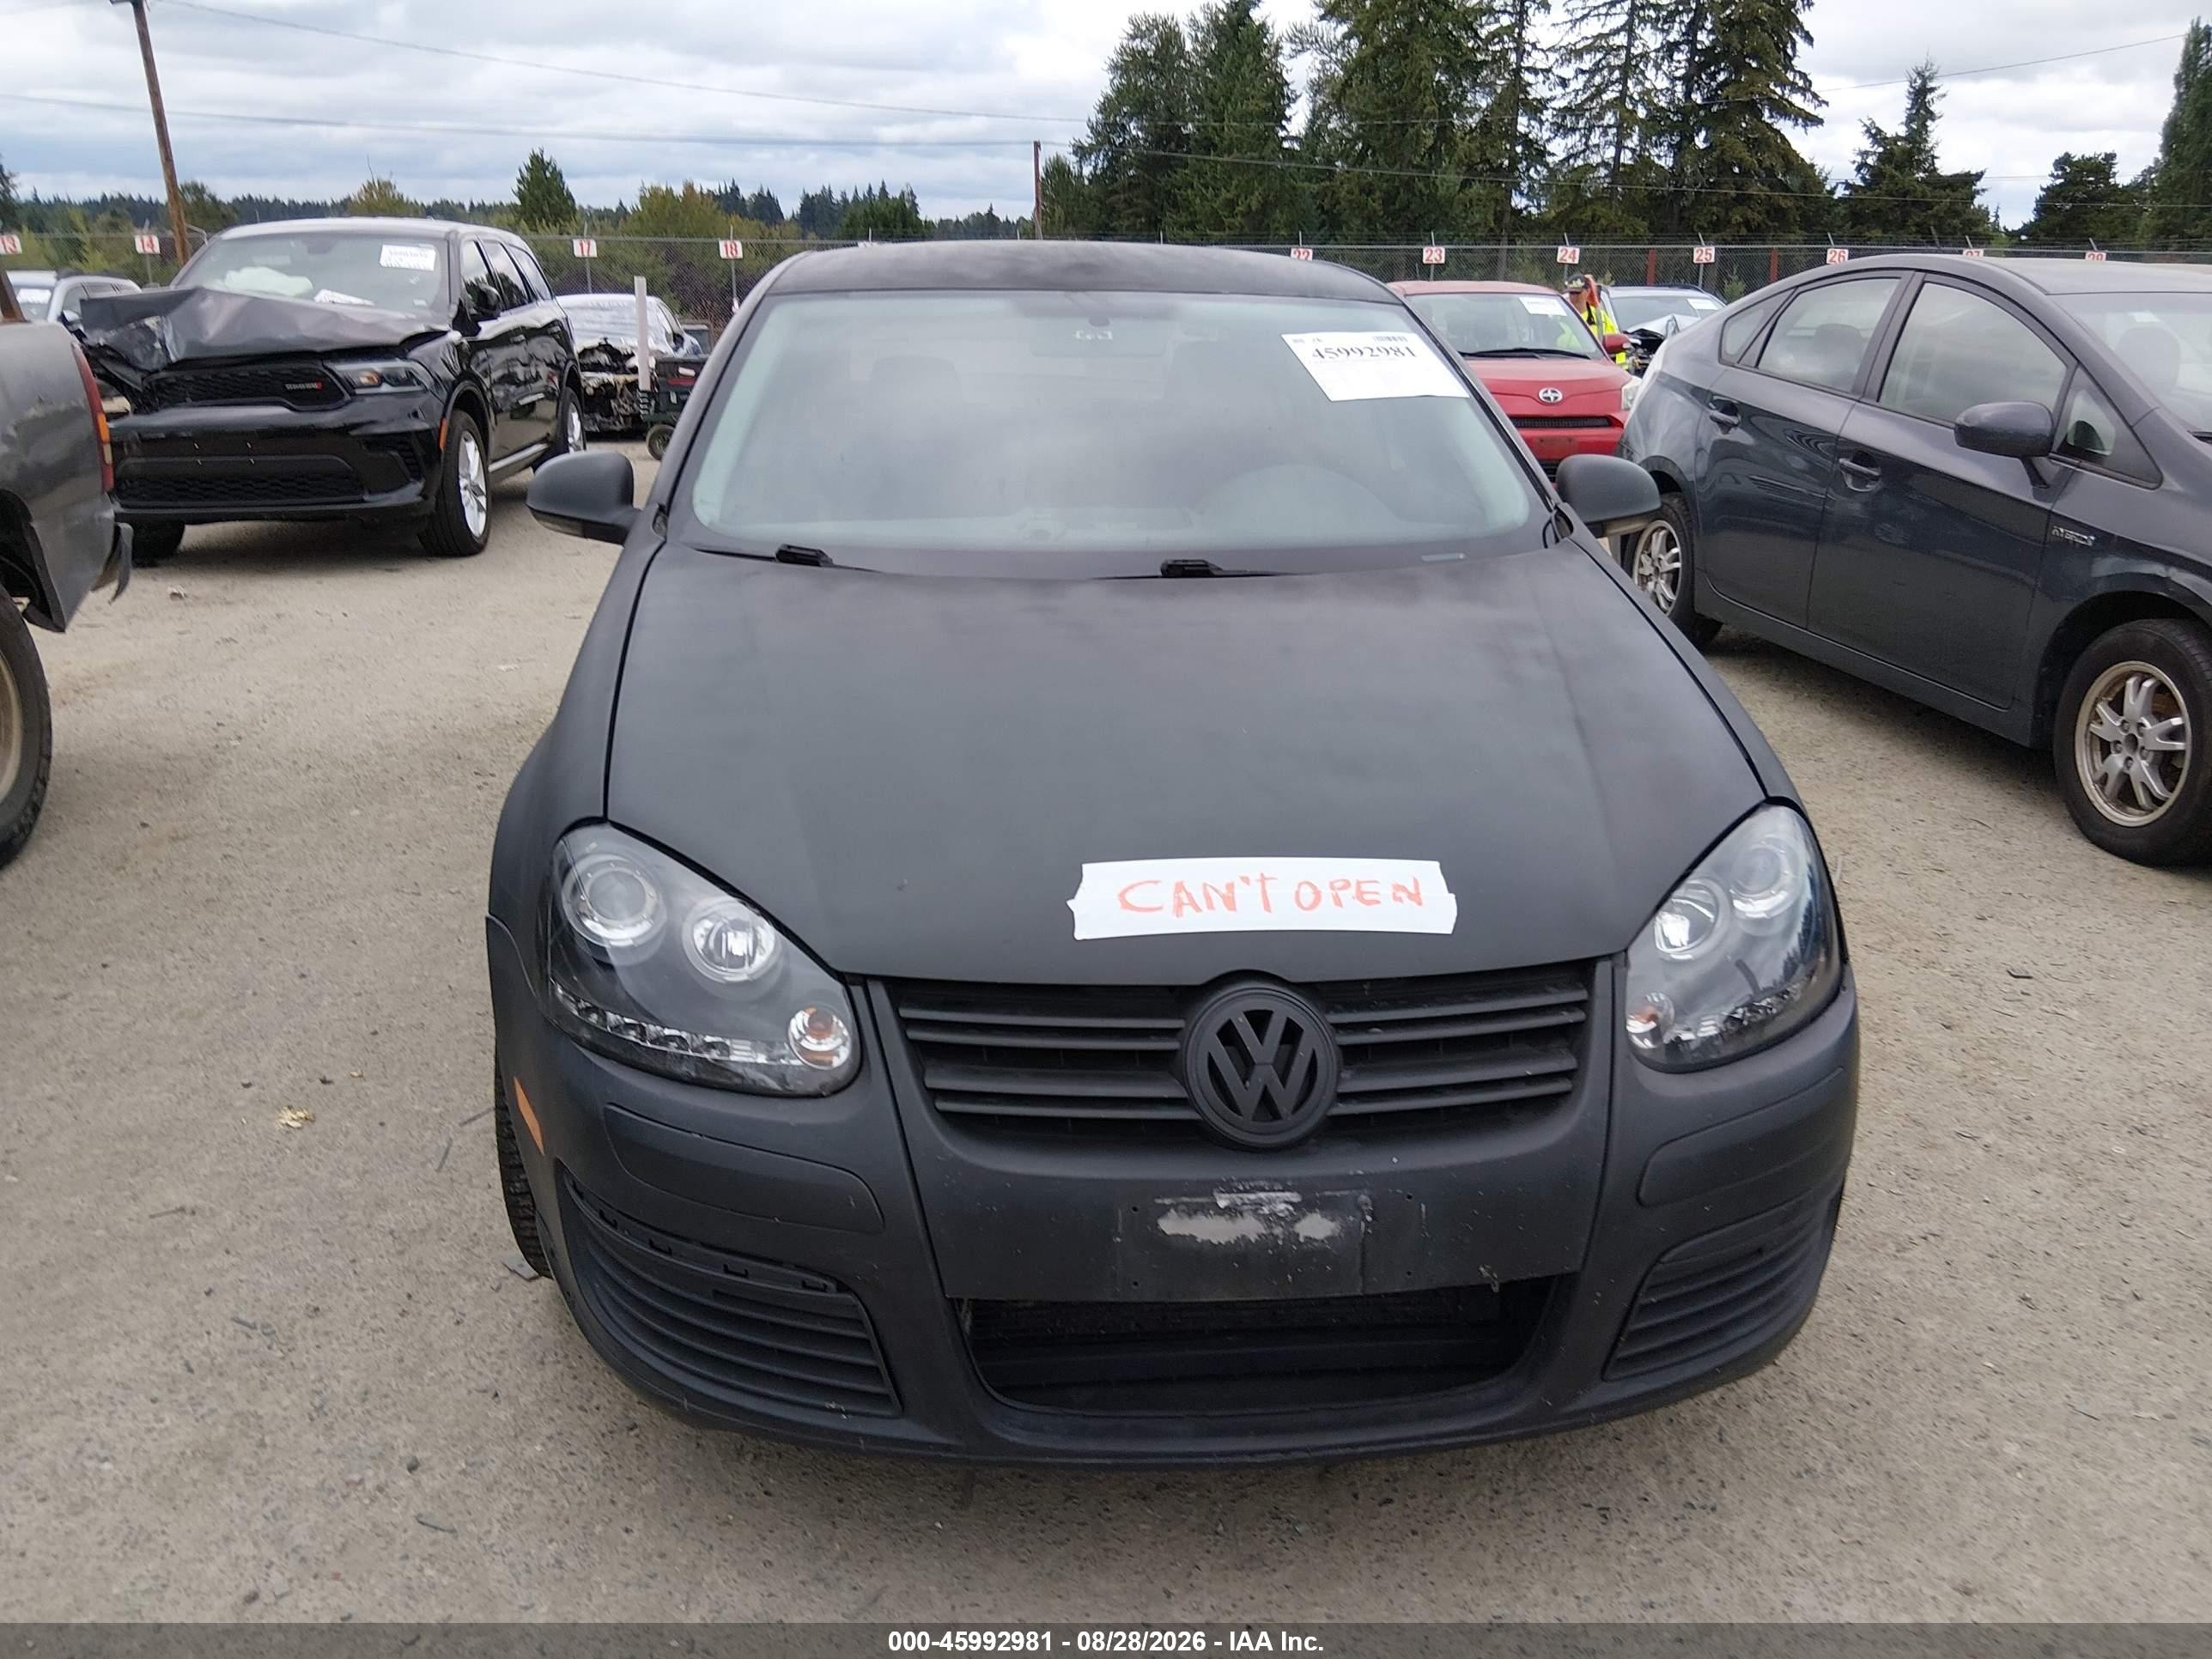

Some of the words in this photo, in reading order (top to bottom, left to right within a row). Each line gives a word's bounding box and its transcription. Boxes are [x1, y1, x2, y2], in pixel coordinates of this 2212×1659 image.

[139, 234, 155, 253] 14
[579, 239, 591, 256] 17
[723, 241, 738, 257] 18
[1293, 249, 1310, 261] 22
[1425, 247, 1443, 263] 23
[1559, 247, 1577, 263] 24
[1695, 247, 1713, 263] 25
[1829, 250, 1846, 264] 26
[1312, 345, 1417, 359] 45992981
[1118, 872, 1278, 918] CAN'T
[1294, 875, 1424, 912] OPEN
[1203, 1003, 1322, 1124] VW
